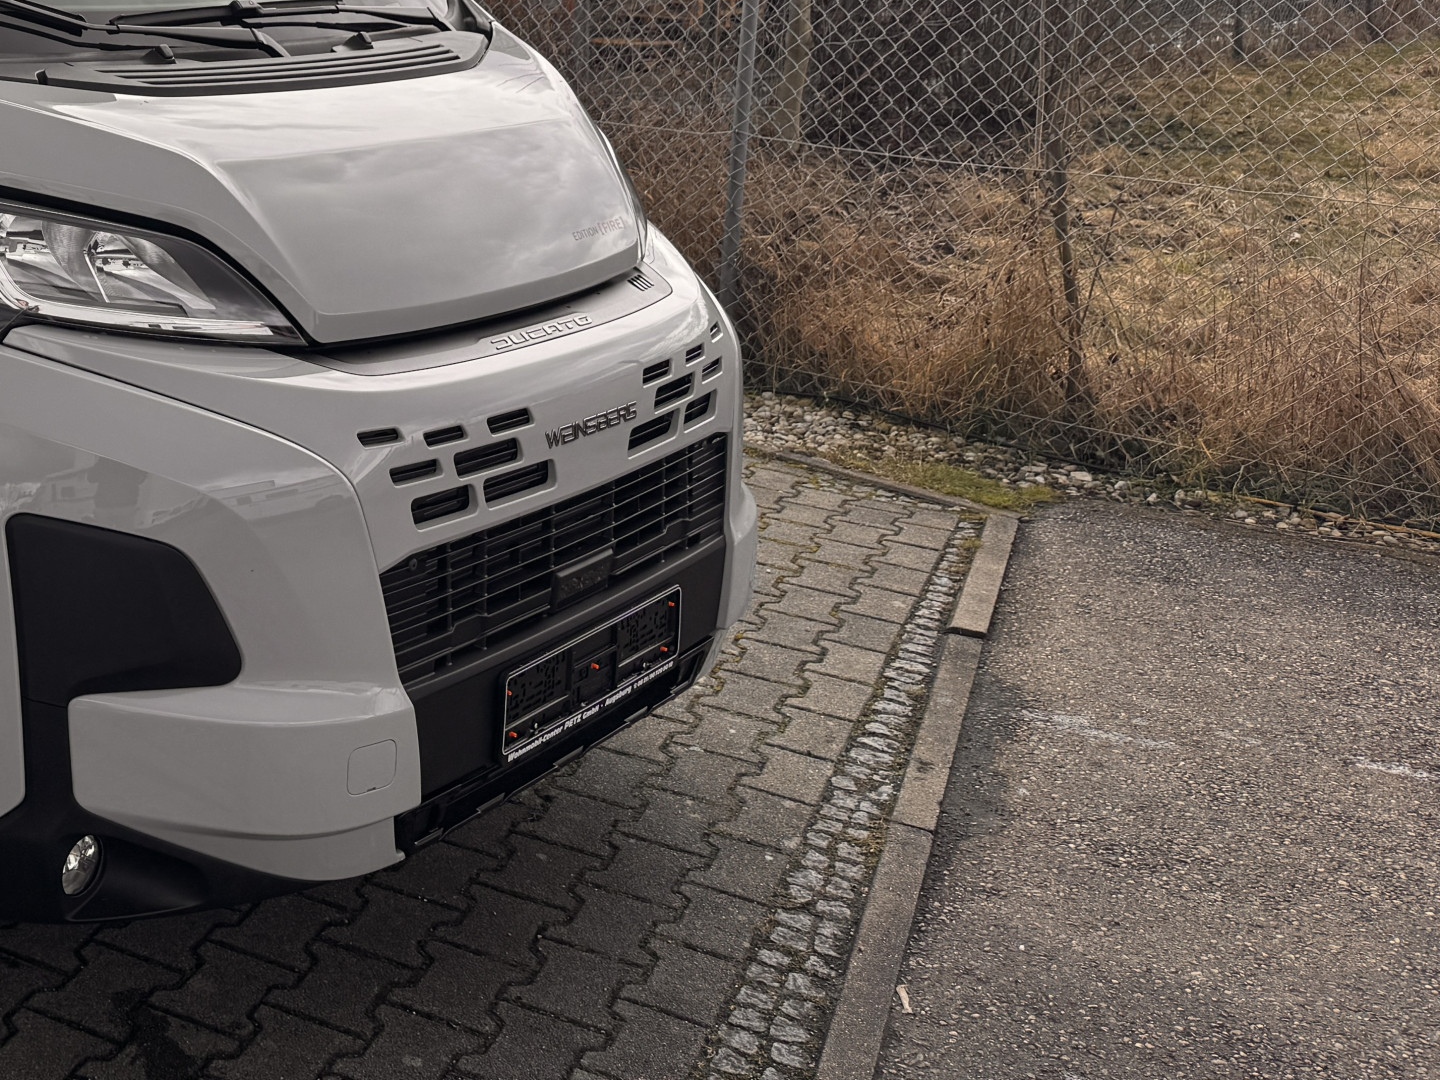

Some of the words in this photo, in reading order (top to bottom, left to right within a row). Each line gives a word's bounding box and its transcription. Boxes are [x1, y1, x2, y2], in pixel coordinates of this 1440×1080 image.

[572, 226, 598, 241] EDITION
[490, 315, 593, 351] DUCATO
[545, 400, 637, 450] WEINSBERG
